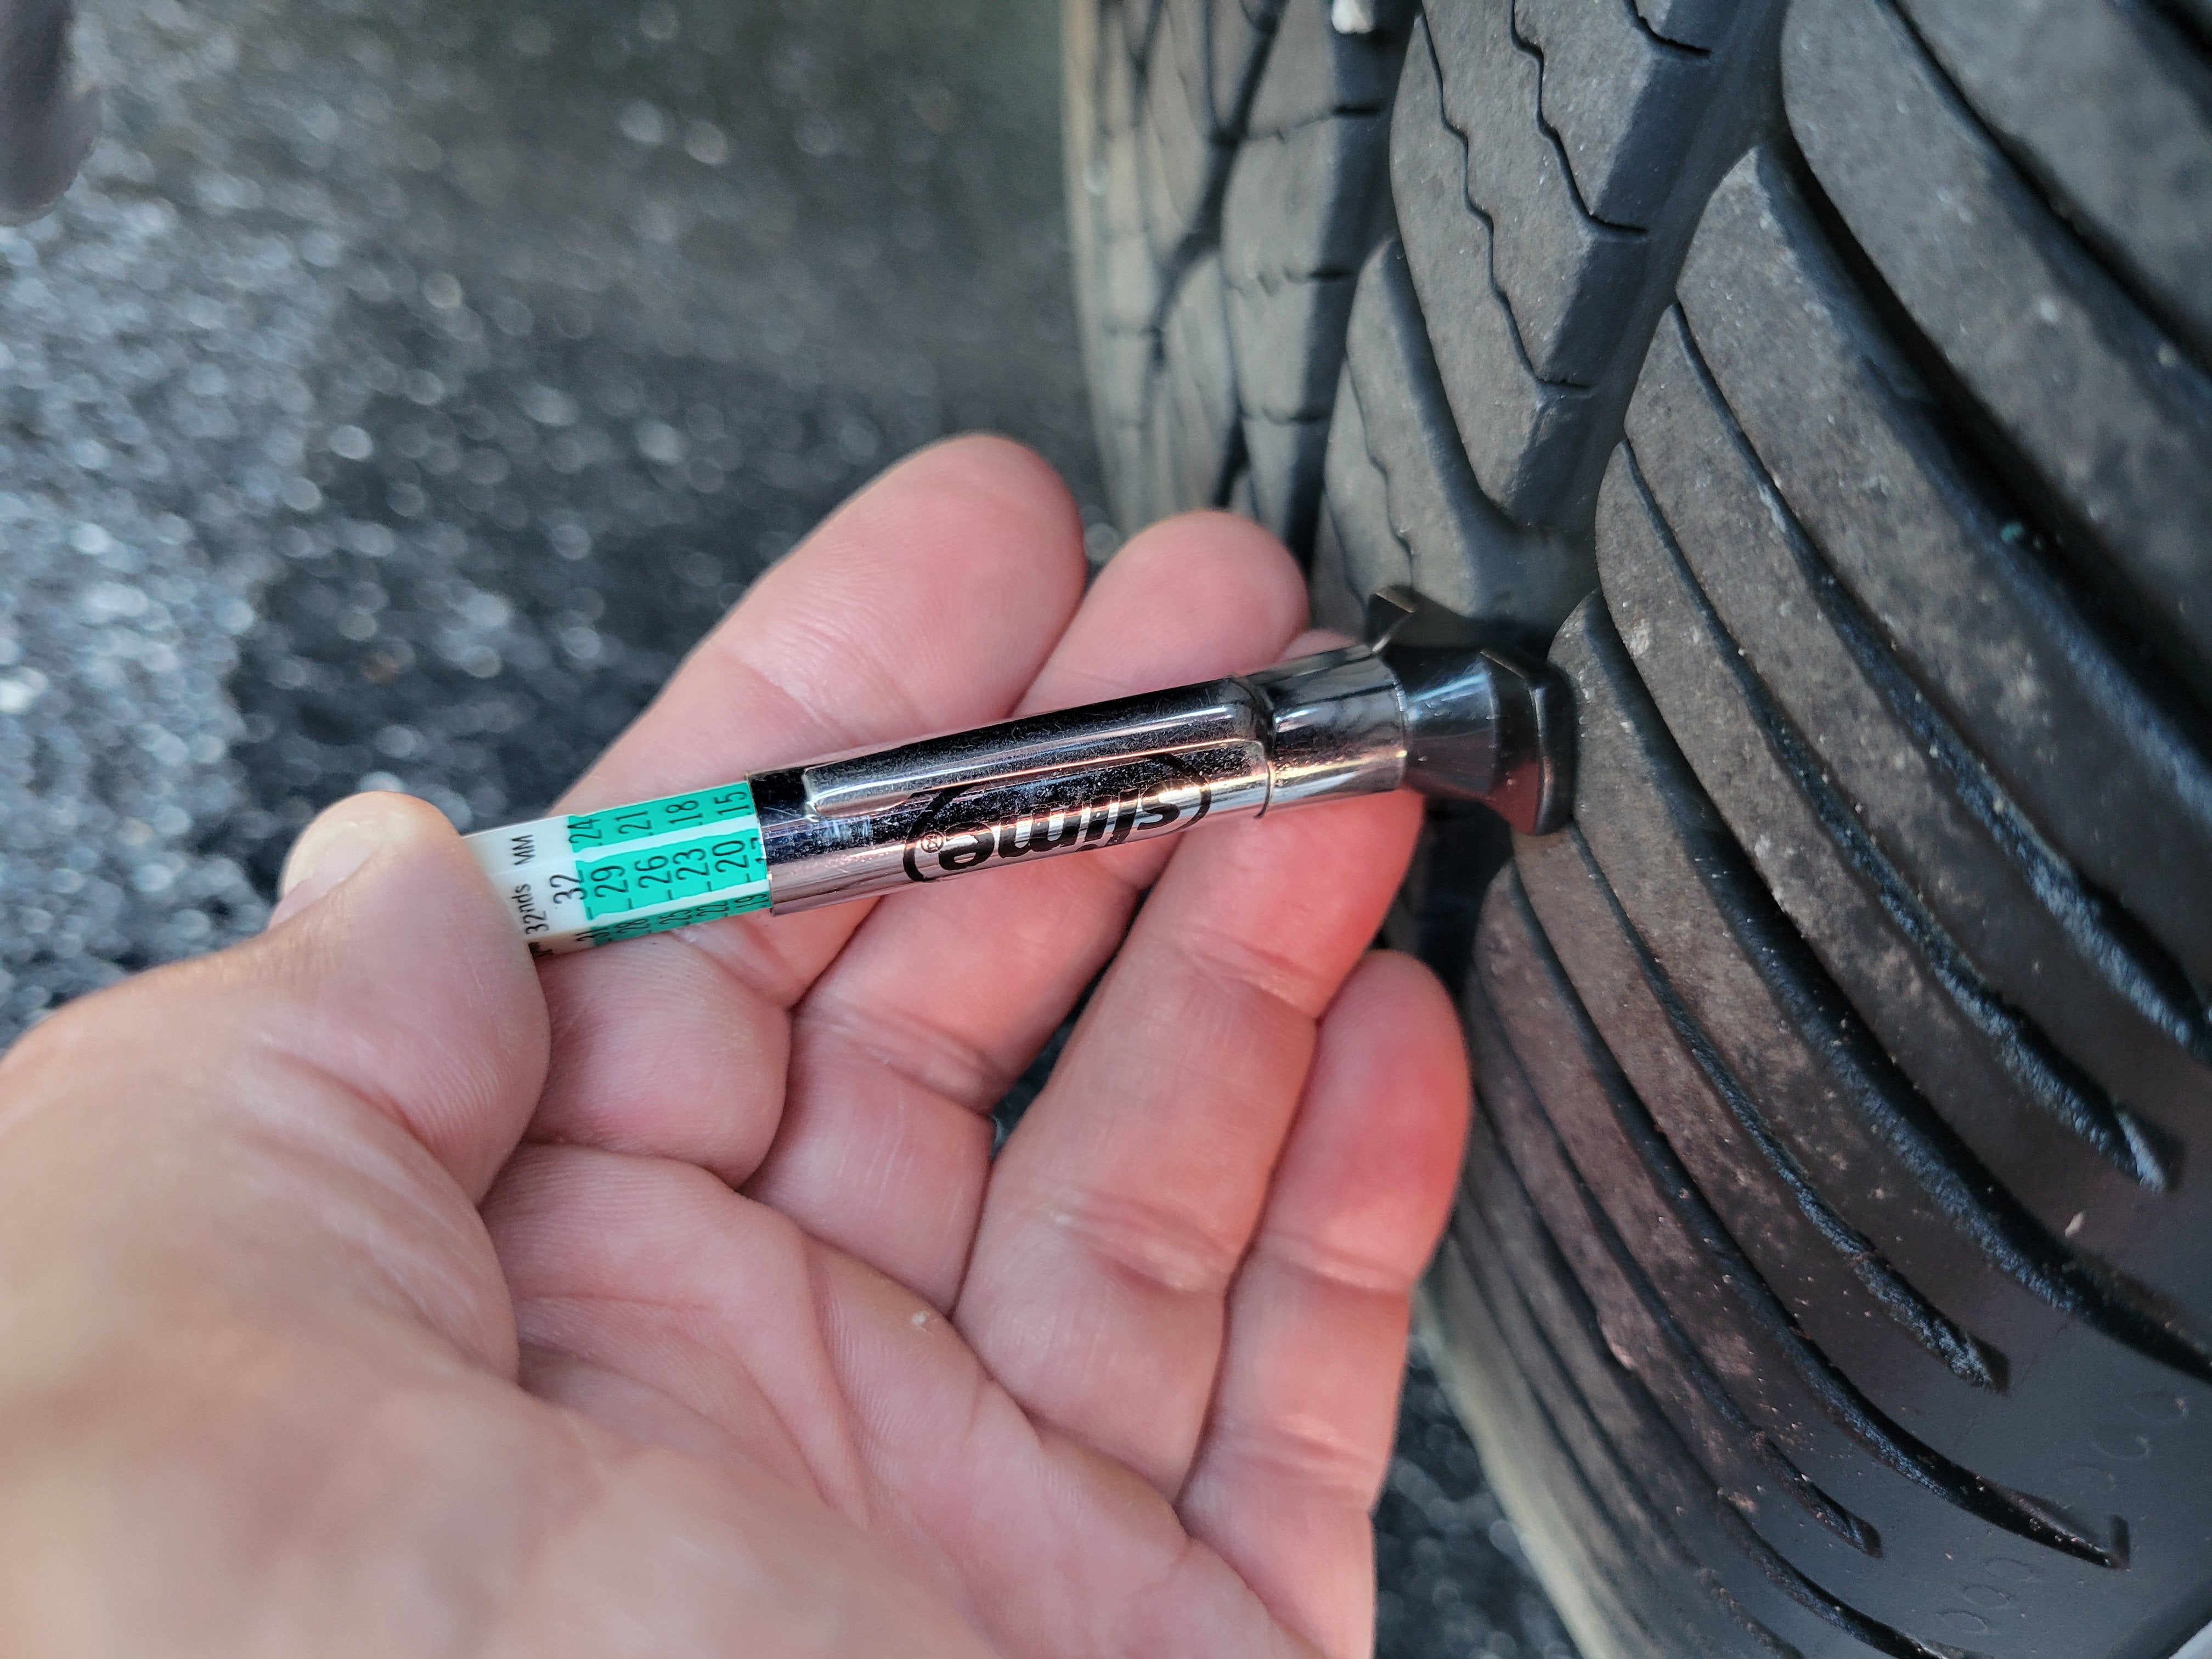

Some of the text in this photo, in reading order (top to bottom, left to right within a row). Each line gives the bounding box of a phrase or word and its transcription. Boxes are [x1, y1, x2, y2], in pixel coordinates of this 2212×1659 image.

[665, 800, 703, 824] 18
[714, 792, 750, 815] 15
[567, 819, 602, 844] 24
[615, 811, 652, 834] 21
[511, 834, 535, 865] MM
[673, 848, 710, 880] 23
[712, 840, 750, 872] 20
[550, 870, 588, 904] 32
[591, 866, 629, 898] 29
[635, 855, 673, 888] 26
[511, 884, 549, 934] 32nds
